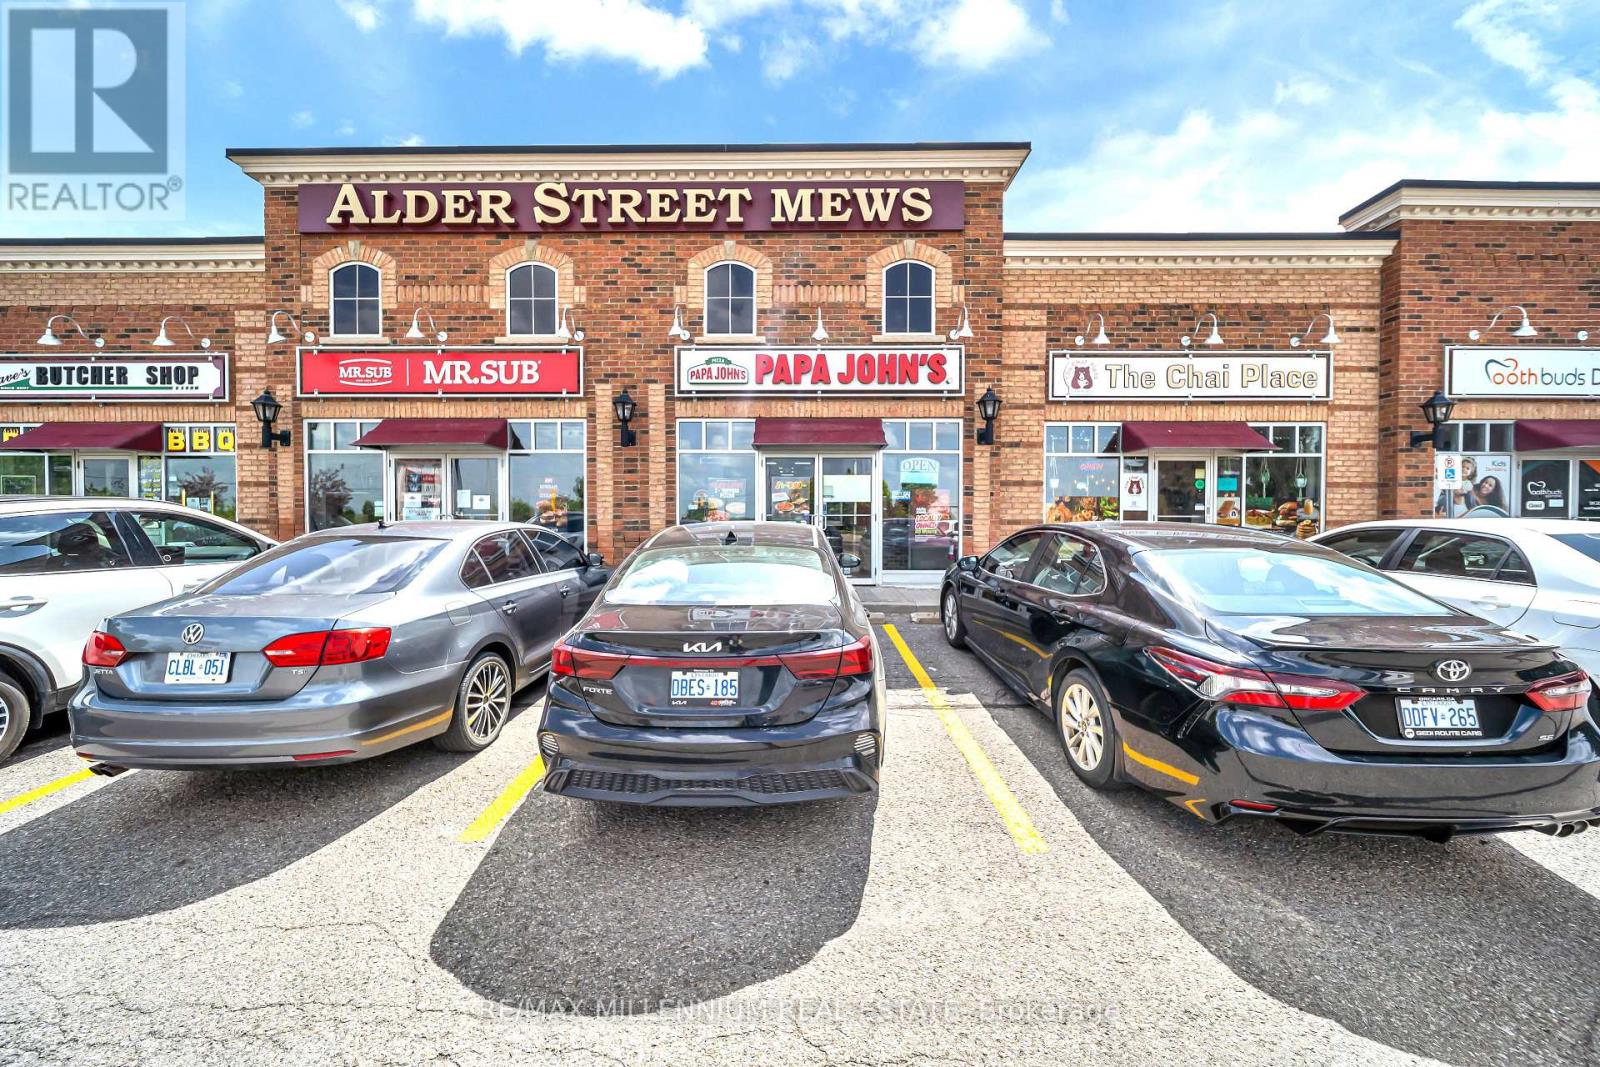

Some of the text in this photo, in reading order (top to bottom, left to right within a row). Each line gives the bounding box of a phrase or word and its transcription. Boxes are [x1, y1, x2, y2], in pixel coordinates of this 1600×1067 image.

[326, 183, 933, 224] ALDER STREET MEWS
[35, 365, 199, 385] BUTCHER SHOP
[339, 366, 392, 378] MR.SUB
[423, 360, 540, 385] MR.SUB
[690, 367, 713, 380] PAPA
[755, 353, 947, 384] PAPA JOHN'S
[1105, 363, 1155, 388] The
[1166, 363, 1230, 388] Chai
[1241, 363, 1319, 388] Place
[168, 428, 235, 452] BBQ
[902, 460, 937, 471] OPEN
[683, 642, 722, 653] KIA
[168, 659, 224, 675] CLBL 051
[582, 686, 612, 695] FORTE
[671, 679, 737, 696] DBES 185
[1402, 707, 1477, 727] DDFV 265
